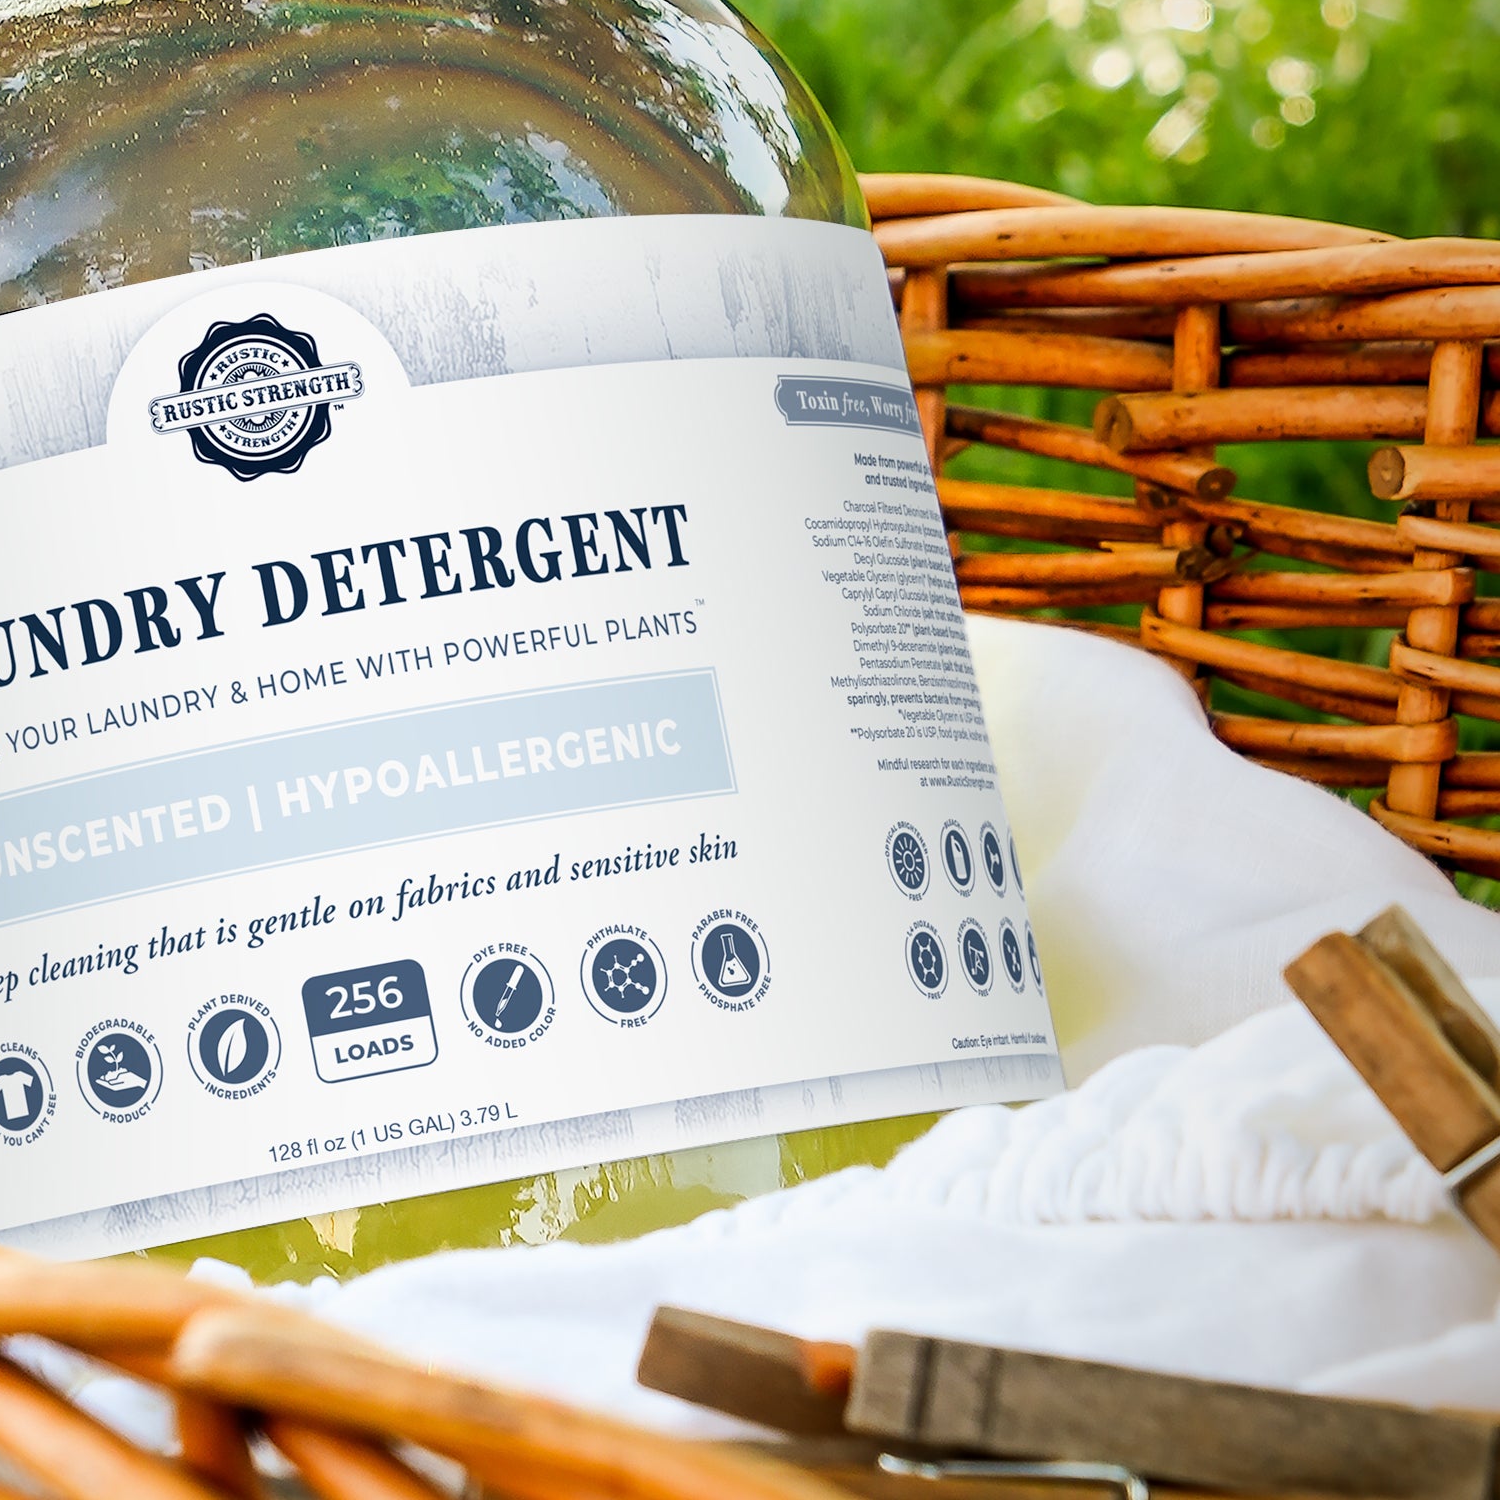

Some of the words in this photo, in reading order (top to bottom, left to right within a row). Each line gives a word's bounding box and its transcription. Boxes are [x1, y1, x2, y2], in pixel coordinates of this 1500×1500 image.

[216, 348, 281, 374] RUSTIC
[163, 392, 237, 422] RUSTIC
[242, 372, 350, 408] STRENGTH
[797, 390, 839, 411] Toxin
[841, 392, 869, 417] free,
[871, 396, 903, 423] Worry
[225, 421, 296, 447] STRENGTH
[854, 453, 876, 467] Made
[878, 455, 896, 468] from
[865, 474, 880, 485] and
[882, 474, 907, 488] trusted
[843, 500, 877, 513] Charcoal
[812, 535, 846, 548] Sodium
[252, 504, 689, 627] DETERGENT
[854, 553, 876, 566] Decyl
[877, 554, 909, 566] Glucoside
[822, 570, 865, 584] Vegetable
[866, 571, 896, 584] Glycerin
[863, 605, 892, 617] Sodium
[894, 606, 921, 619] Chloride
[851, 623, 897, 636] Polysorbate
[853, 640, 890, 653] Dimethyl
[860, 657, 910, 670] Pentasodium
[5, 717, 77, 753] YOUR
[87, 686, 217, 734] LAUNDRY
[230, 681, 248, 704] &
[257, 661, 347, 698] HOME
[357, 646, 433, 679] WITH
[444, 623, 597, 666] POWERFUL
[605, 611, 697, 641] PLANTS
[847, 692, 889, 707] sparingly,
[891, 694, 922, 706] prevents
[276, 718, 682, 818] HYPOALLERGENIC
[878, 758, 909, 771] Mindful
[910, 758, 940, 771] research
[941, 758, 950, 770] for
[920, 776, 928, 787] at
[944, 818, 960, 828] BLEACH
[884, 825, 897, 857] OPTICAL
[29, 943, 139, 974] cleaning
[148, 925, 206, 960] that
[216, 918, 238, 946] is
[247, 895, 337, 948] gentle
[349, 894, 385, 920] on
[392, 872, 496, 922] fabrics
[506, 854, 561, 891] and
[570, 843, 680, 883] sensitive
[689, 833, 738, 865] skin
[908, 893, 922, 901] FREE
[959, 889, 970, 897] FREE
[692, 909, 733, 940] PARABEN
[735, 911, 759, 933] FREE
[913, 920, 937, 934] DIOXANE
[587, 924, 648, 949] PHTHALATE
[473, 945, 496, 964] DYE
[499, 943, 528, 956] FREE
[325, 976, 403, 1019] 256
[698, 983, 755, 1013] PHOSPHATE
[756, 974, 771, 1002] FREE
[978, 988, 988, 996] FREE
[188, 998, 218, 1031] PLANT
[220, 994, 270, 1017] DERIVED
[620, 1016, 647, 1028] FREE
[75, 1018, 155, 1059] BIODEGRADABLE
[467, 1021, 483, 1037] NO
[485, 1037, 527, 1049] ADDED
[529, 1007, 556, 1042] COLOR
[0, 1042, 38, 1060] CLEANS
[334, 1035, 414, 1064] LOADS
[952, 1037, 980, 1049] Caution:
[980, 1034, 991, 1048] Eye
[204, 1069, 277, 1100] INGREDIENTS
[3, 1134, 22, 1146] YOU
[25, 1117, 50, 1144] CAN'T
[46, 1093, 56, 1116] SEE
[102, 1102, 152, 1124] PRODUCT
[269, 1141, 302, 1162] 128
[307, 1138, 319, 1154] fl
[324, 1136, 346, 1152] oz
[351, 1130, 365, 1150] (1
[374, 1123, 403, 1143] US
[409, 1113, 455, 1136] GAL)
[460, 1104, 499, 1127] 3.79
[506, 1102, 518, 1119] L
